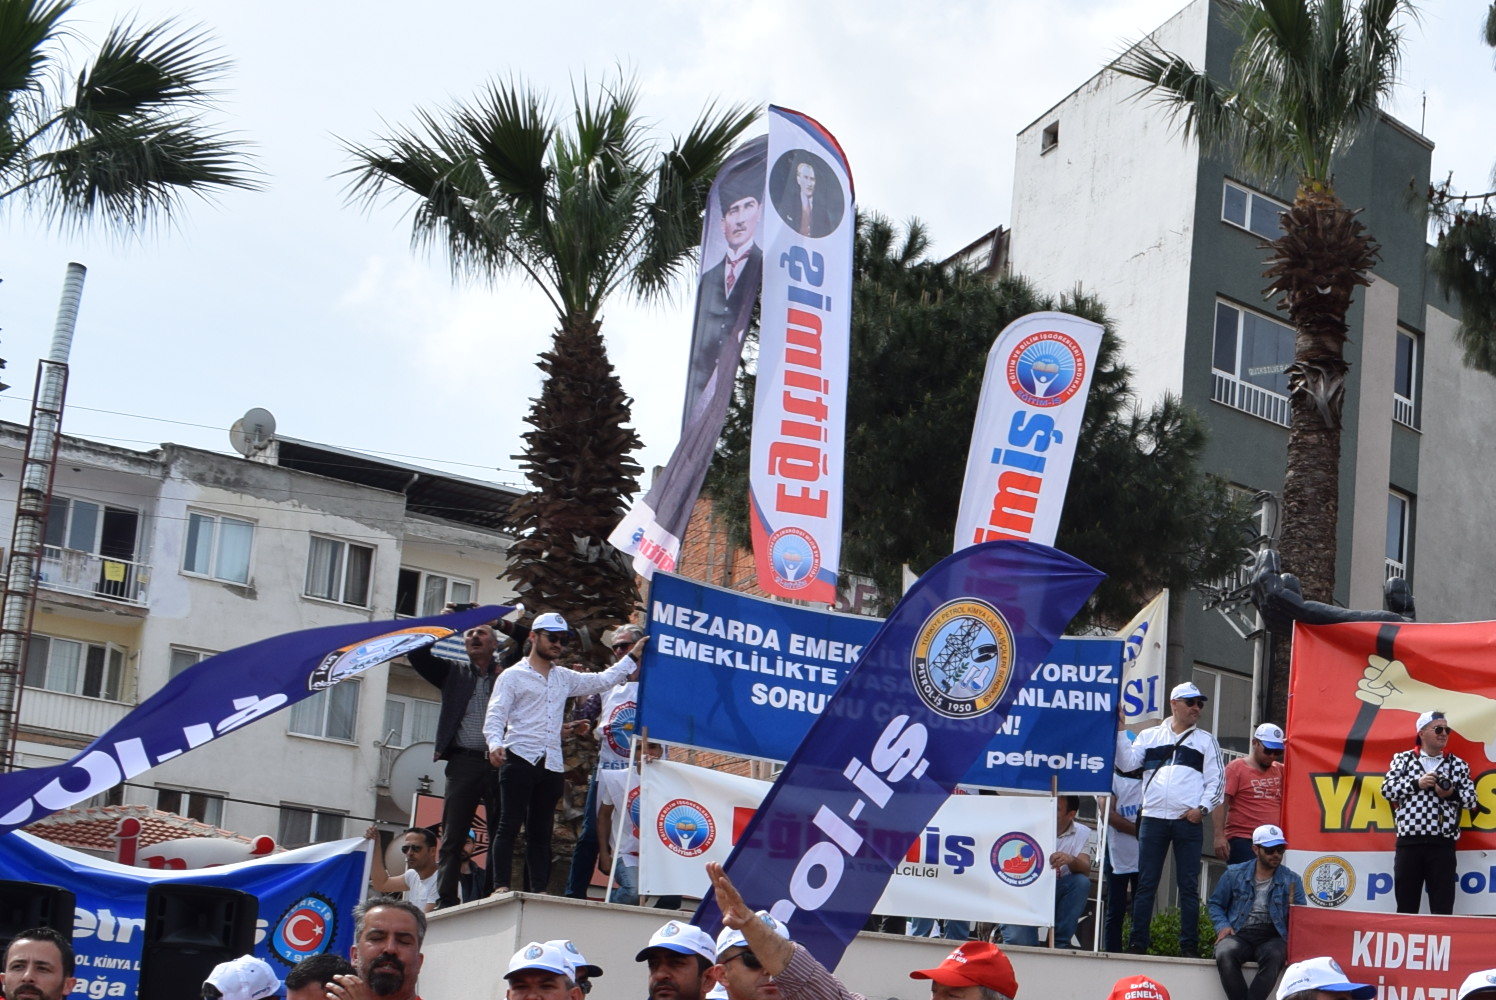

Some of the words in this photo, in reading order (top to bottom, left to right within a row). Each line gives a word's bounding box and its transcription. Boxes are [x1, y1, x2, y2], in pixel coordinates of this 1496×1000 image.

[652, 600, 781, 652] MEZARDA
[657, 633, 838, 686] EMEKLİLİKTE
[917, 662, 944, 707] PETROL-İŞ
[947, 702, 972, 712] 1950
[986, 750, 1105, 774] petrol-iş
[93, 954, 132, 971] KİMYA
[1351, 930, 1451, 972] KIDEM
